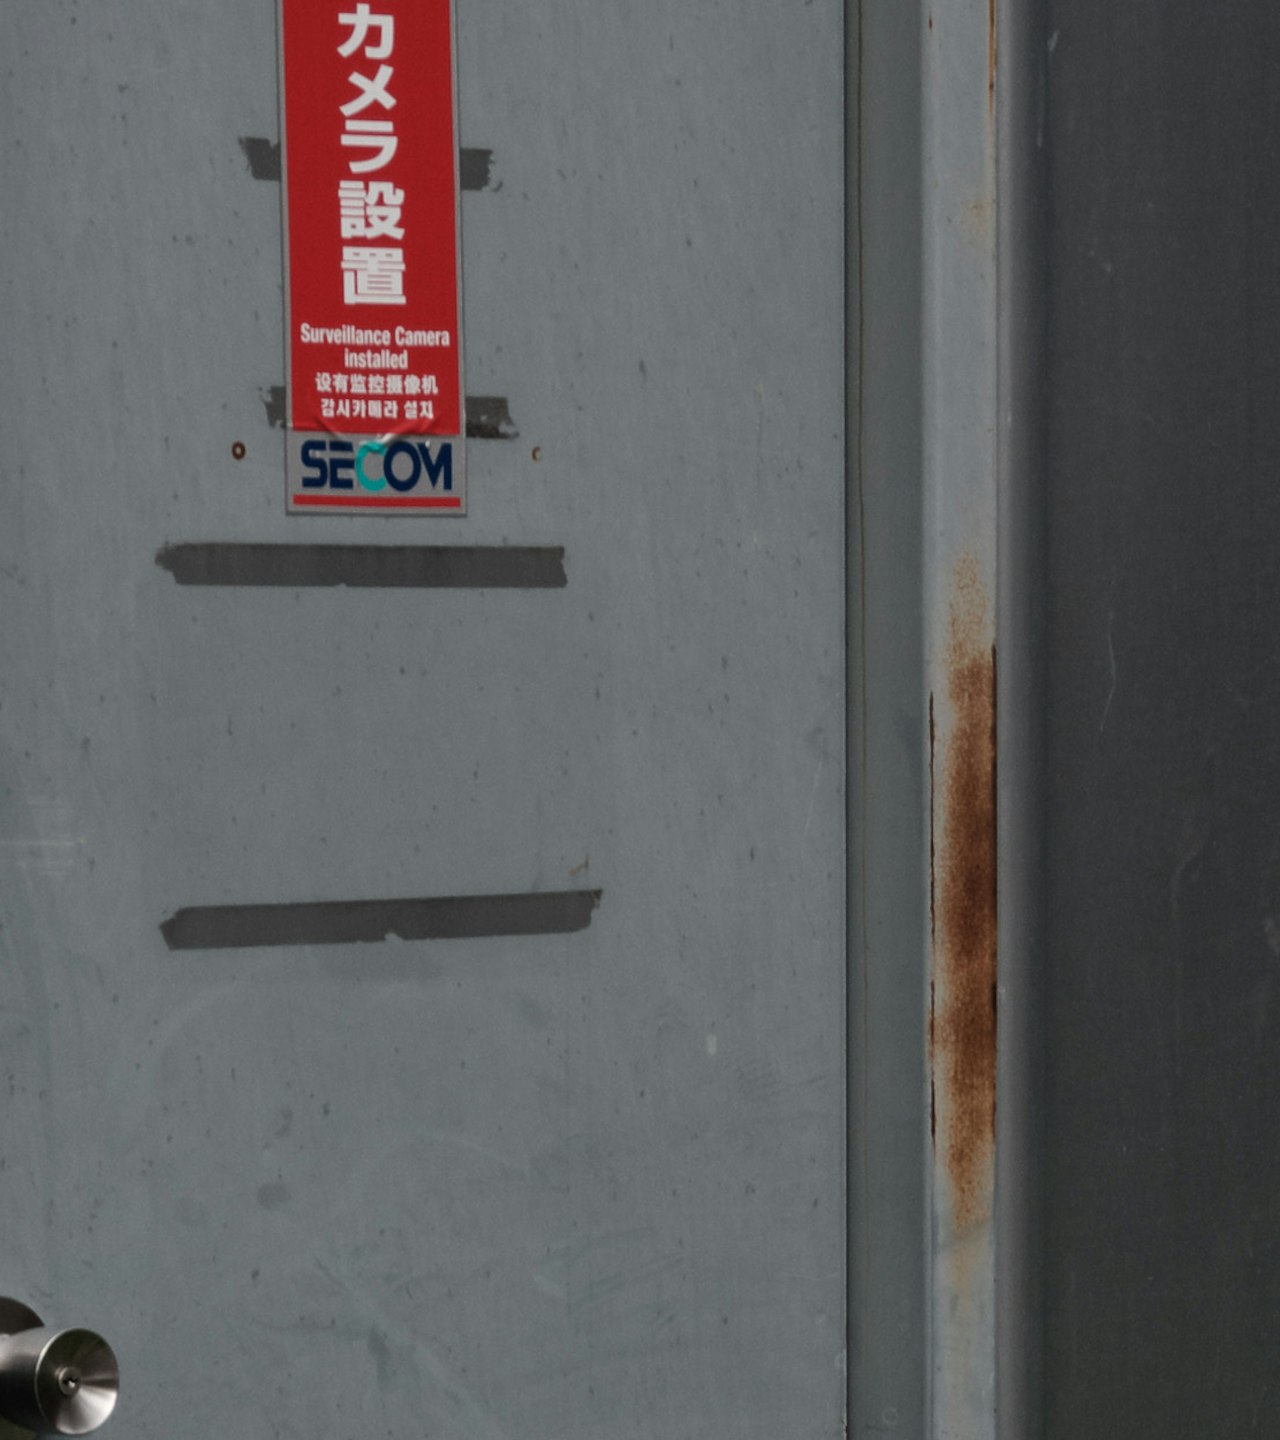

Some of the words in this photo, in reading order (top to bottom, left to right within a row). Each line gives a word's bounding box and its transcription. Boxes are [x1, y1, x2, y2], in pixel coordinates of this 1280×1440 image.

[300, 322, 391, 345] Surveillance
[394, 326, 450, 348] Camera
[344, 348, 409, 370] installed
[315, 371, 439, 396] 设有监控摄像机
[320, 397, 399, 420] 감시카메라
[300, 439, 453, 493] SECOM
